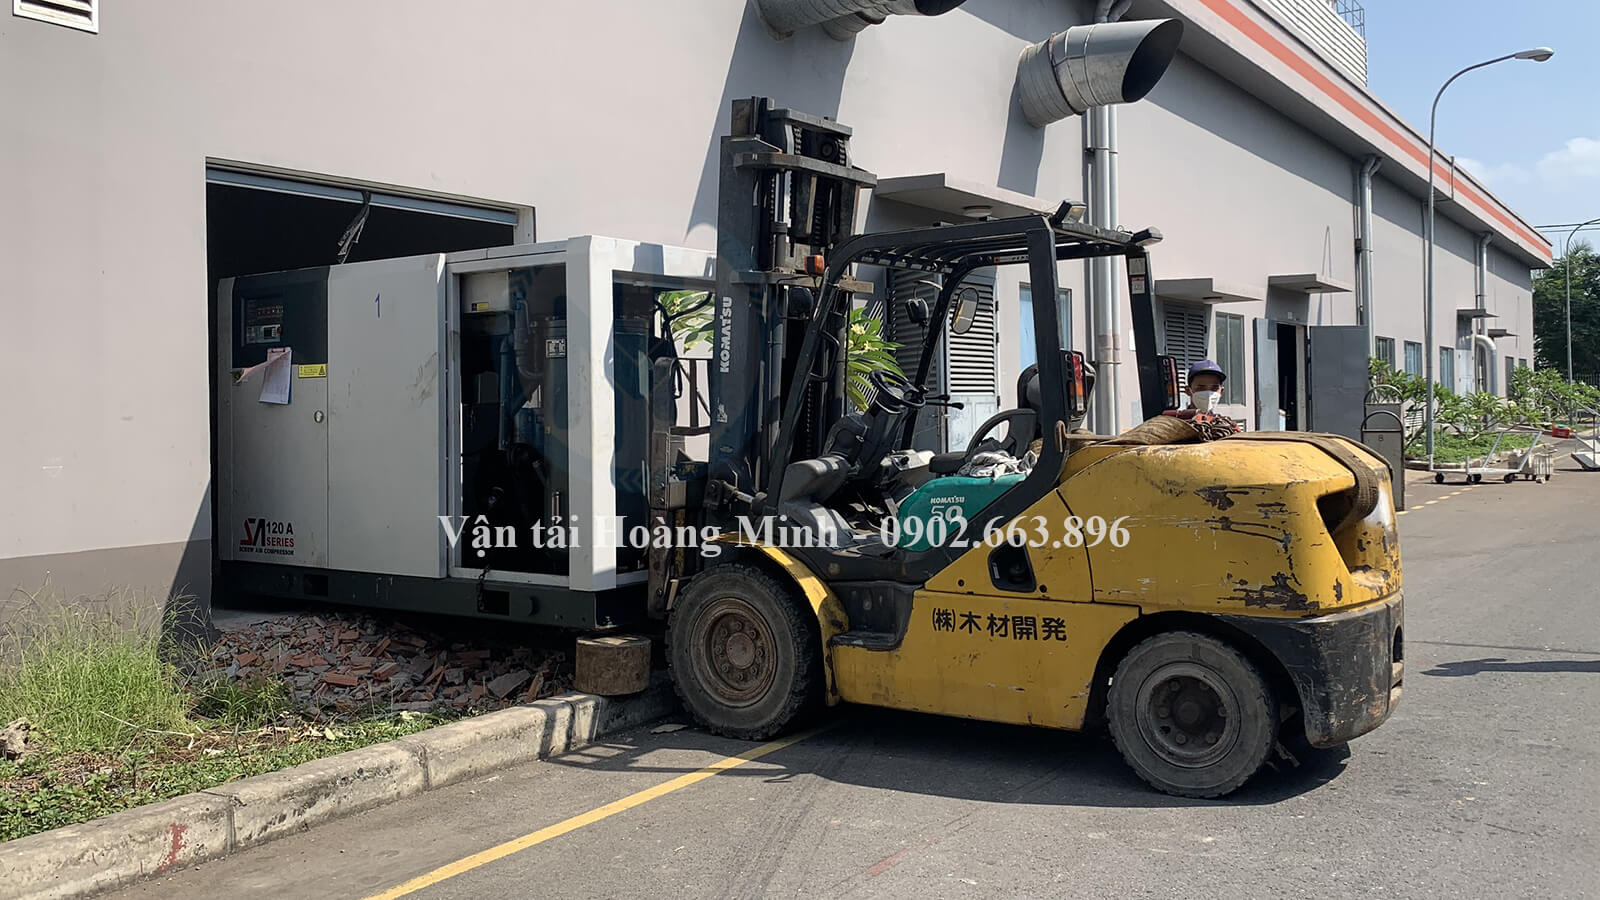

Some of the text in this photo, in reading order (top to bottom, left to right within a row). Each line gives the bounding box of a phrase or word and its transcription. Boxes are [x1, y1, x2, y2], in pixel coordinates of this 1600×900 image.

[719, 296, 733, 373] KOMATSU
[930, 495, 965, 505] KOMATSU
[266, 521, 294, 535] 120 A
[266, 536, 295, 548] SERIES
